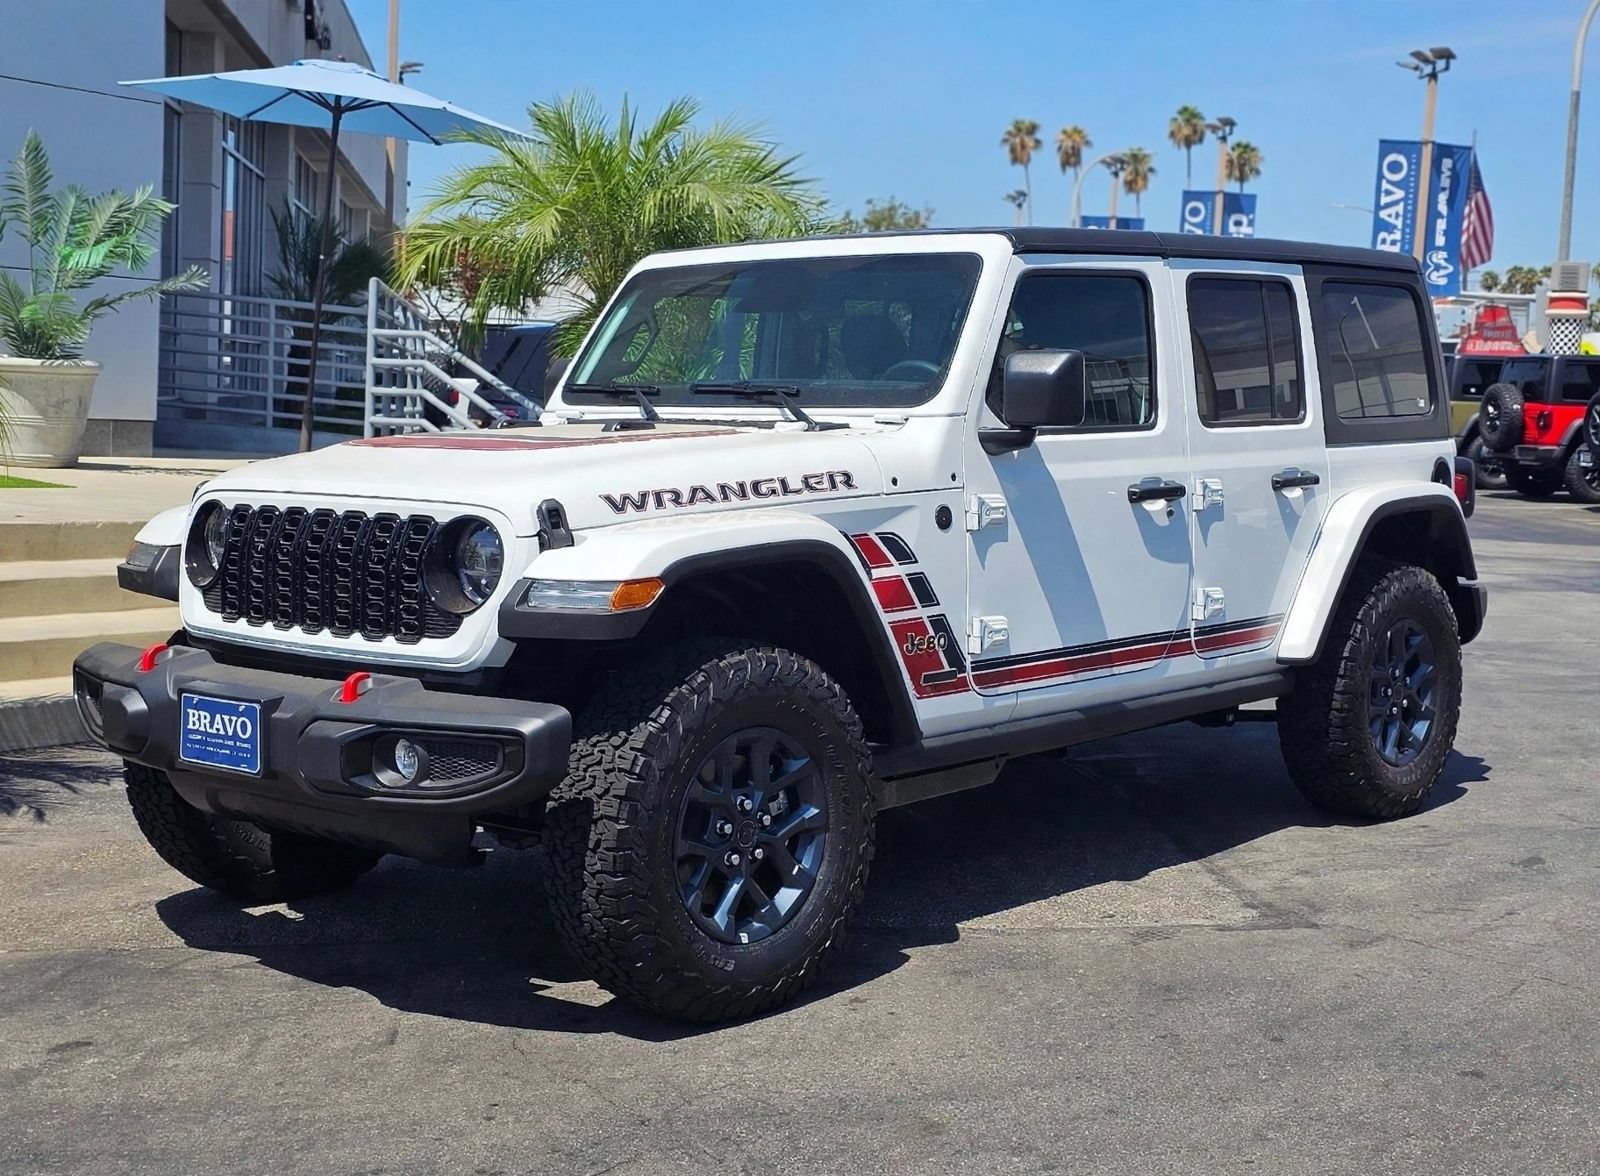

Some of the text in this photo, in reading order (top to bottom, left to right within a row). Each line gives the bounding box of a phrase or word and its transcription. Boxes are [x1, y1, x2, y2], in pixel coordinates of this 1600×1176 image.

[1376, 152, 1409, 252] RAVO
[599, 469, 858, 514] WRANGLER
[187, 708, 252, 739] BRAVO
